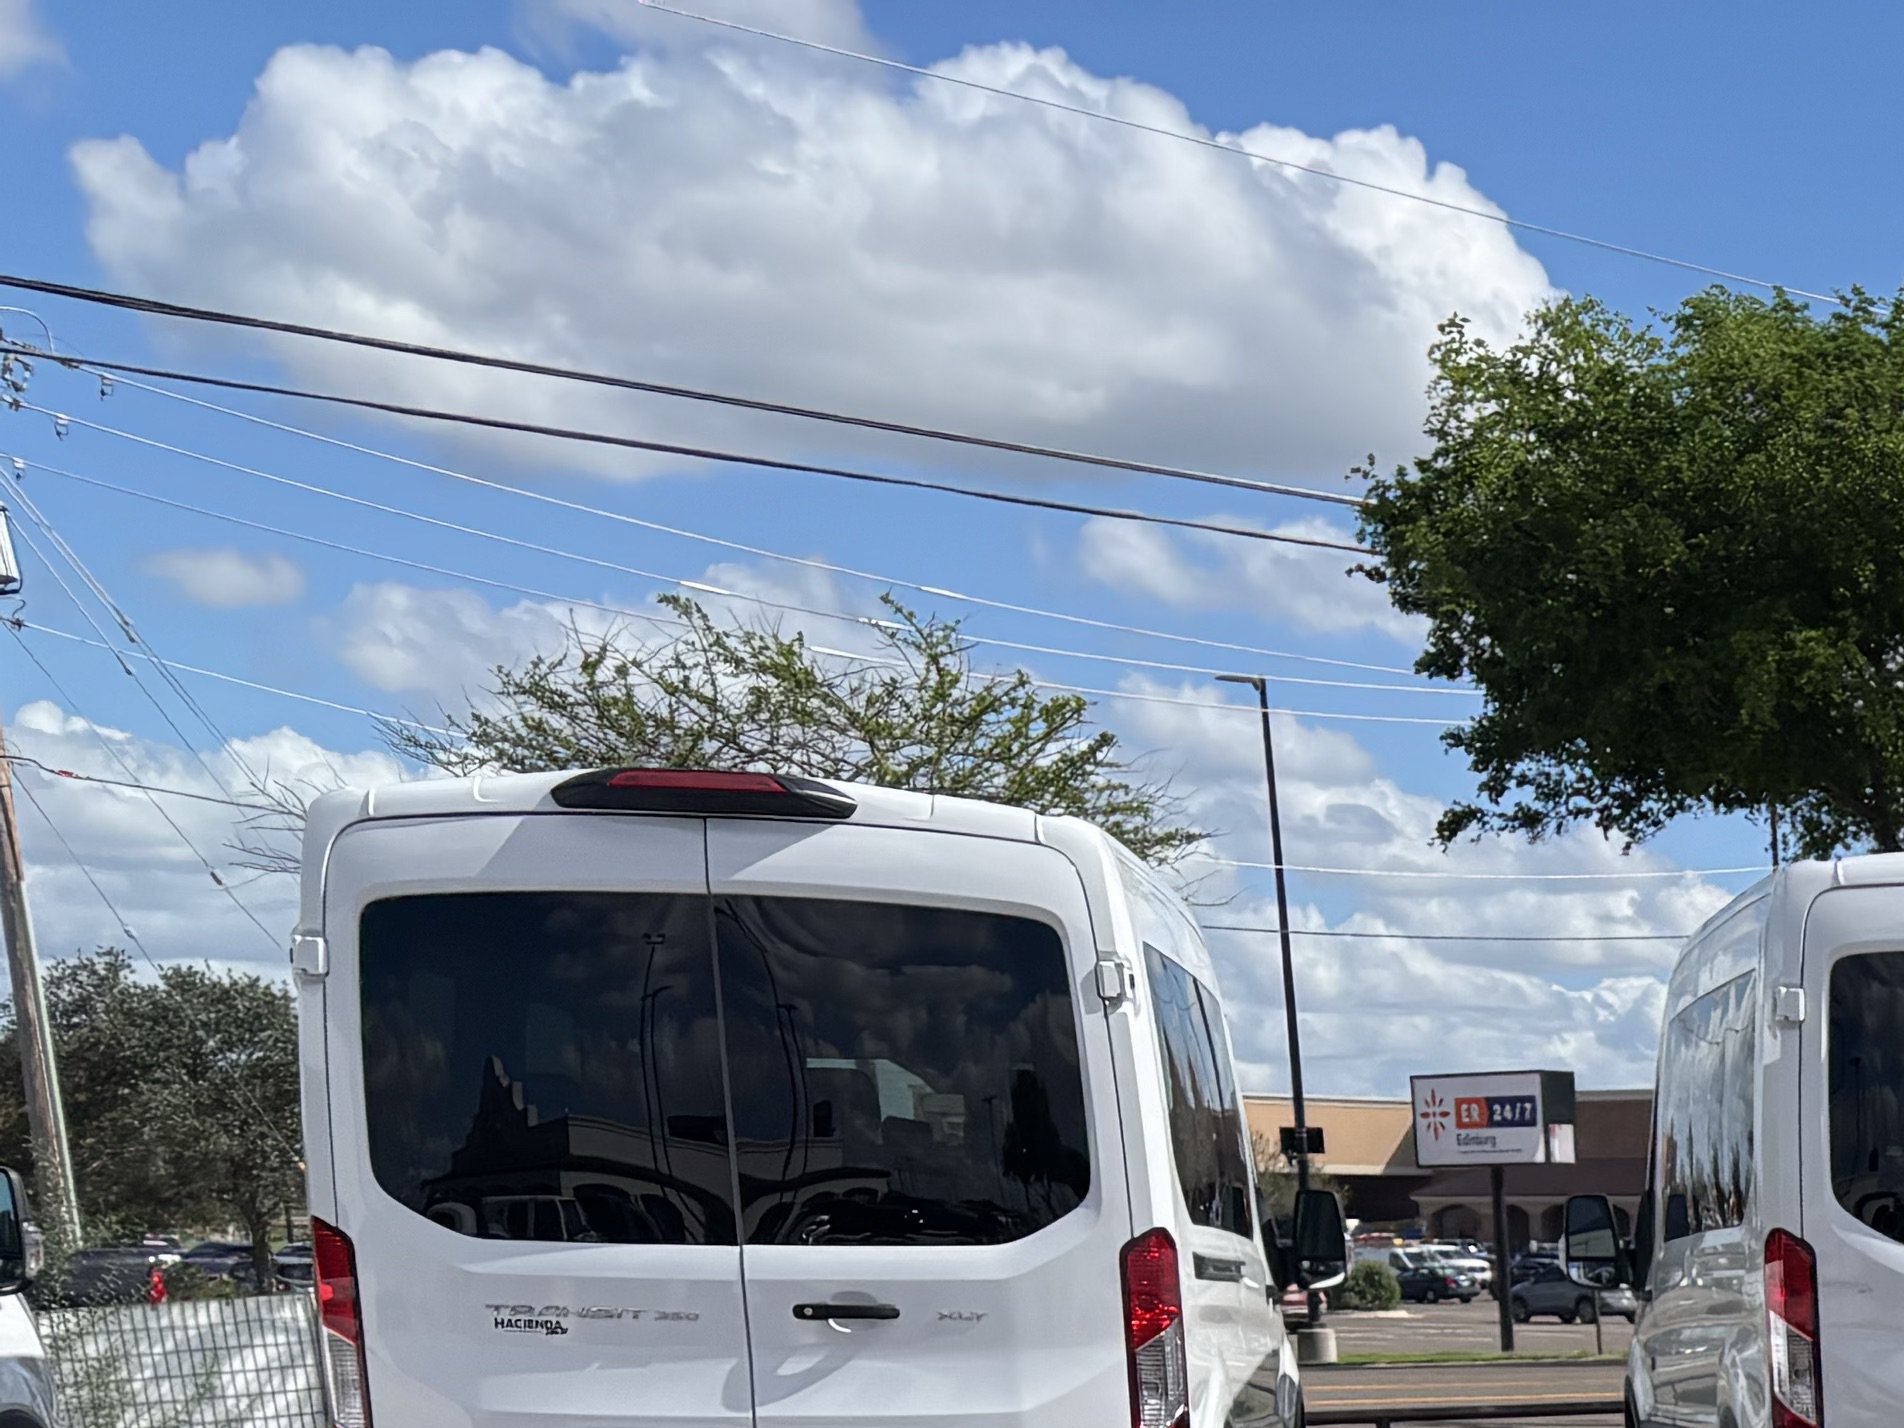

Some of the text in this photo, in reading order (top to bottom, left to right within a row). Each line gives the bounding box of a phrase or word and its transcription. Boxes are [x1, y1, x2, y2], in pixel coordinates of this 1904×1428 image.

[1460, 1102, 1533, 1122] ER 24/7
[485, 1303, 648, 1319] TRANSIT
[494, 1317, 563, 1330] HACIENDA
